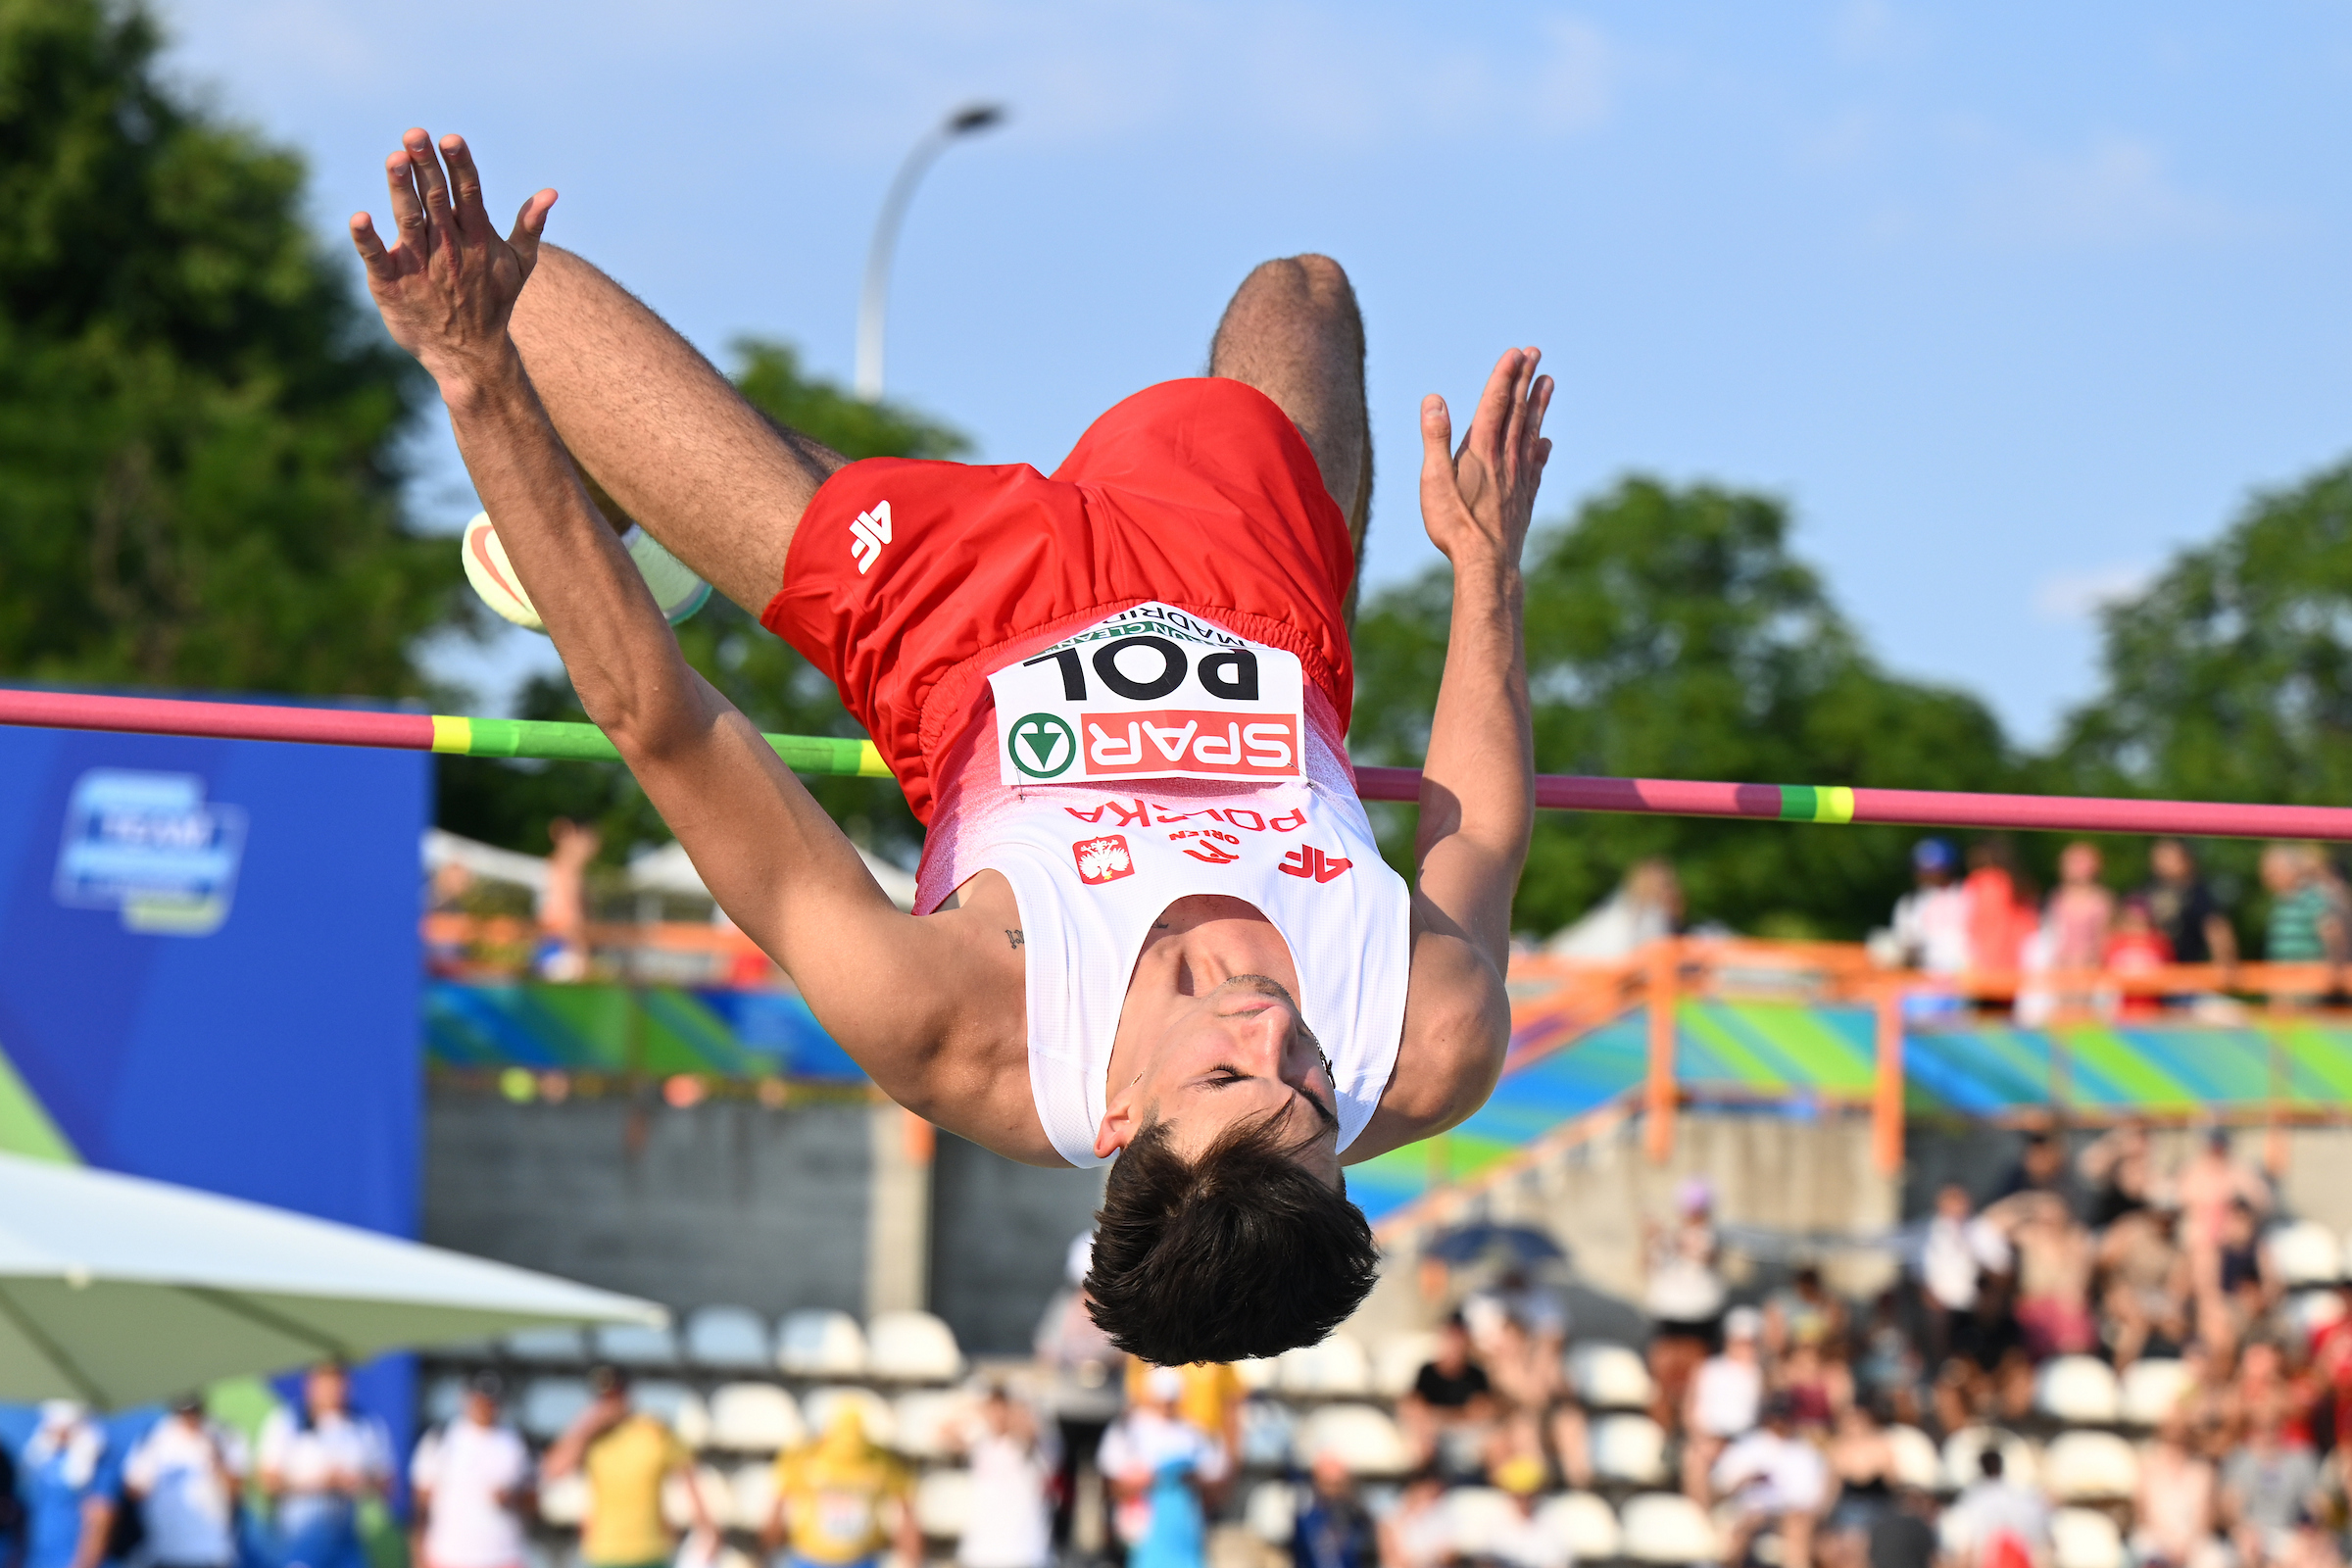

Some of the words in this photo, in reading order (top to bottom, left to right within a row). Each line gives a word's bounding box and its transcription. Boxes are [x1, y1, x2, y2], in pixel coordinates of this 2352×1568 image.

[1023, 635, 1259, 701] POL
[1088, 719, 1292, 767] SPAR
[1063, 799, 1307, 833] POLSKA
[1168, 829, 1241, 846] ORLEN
